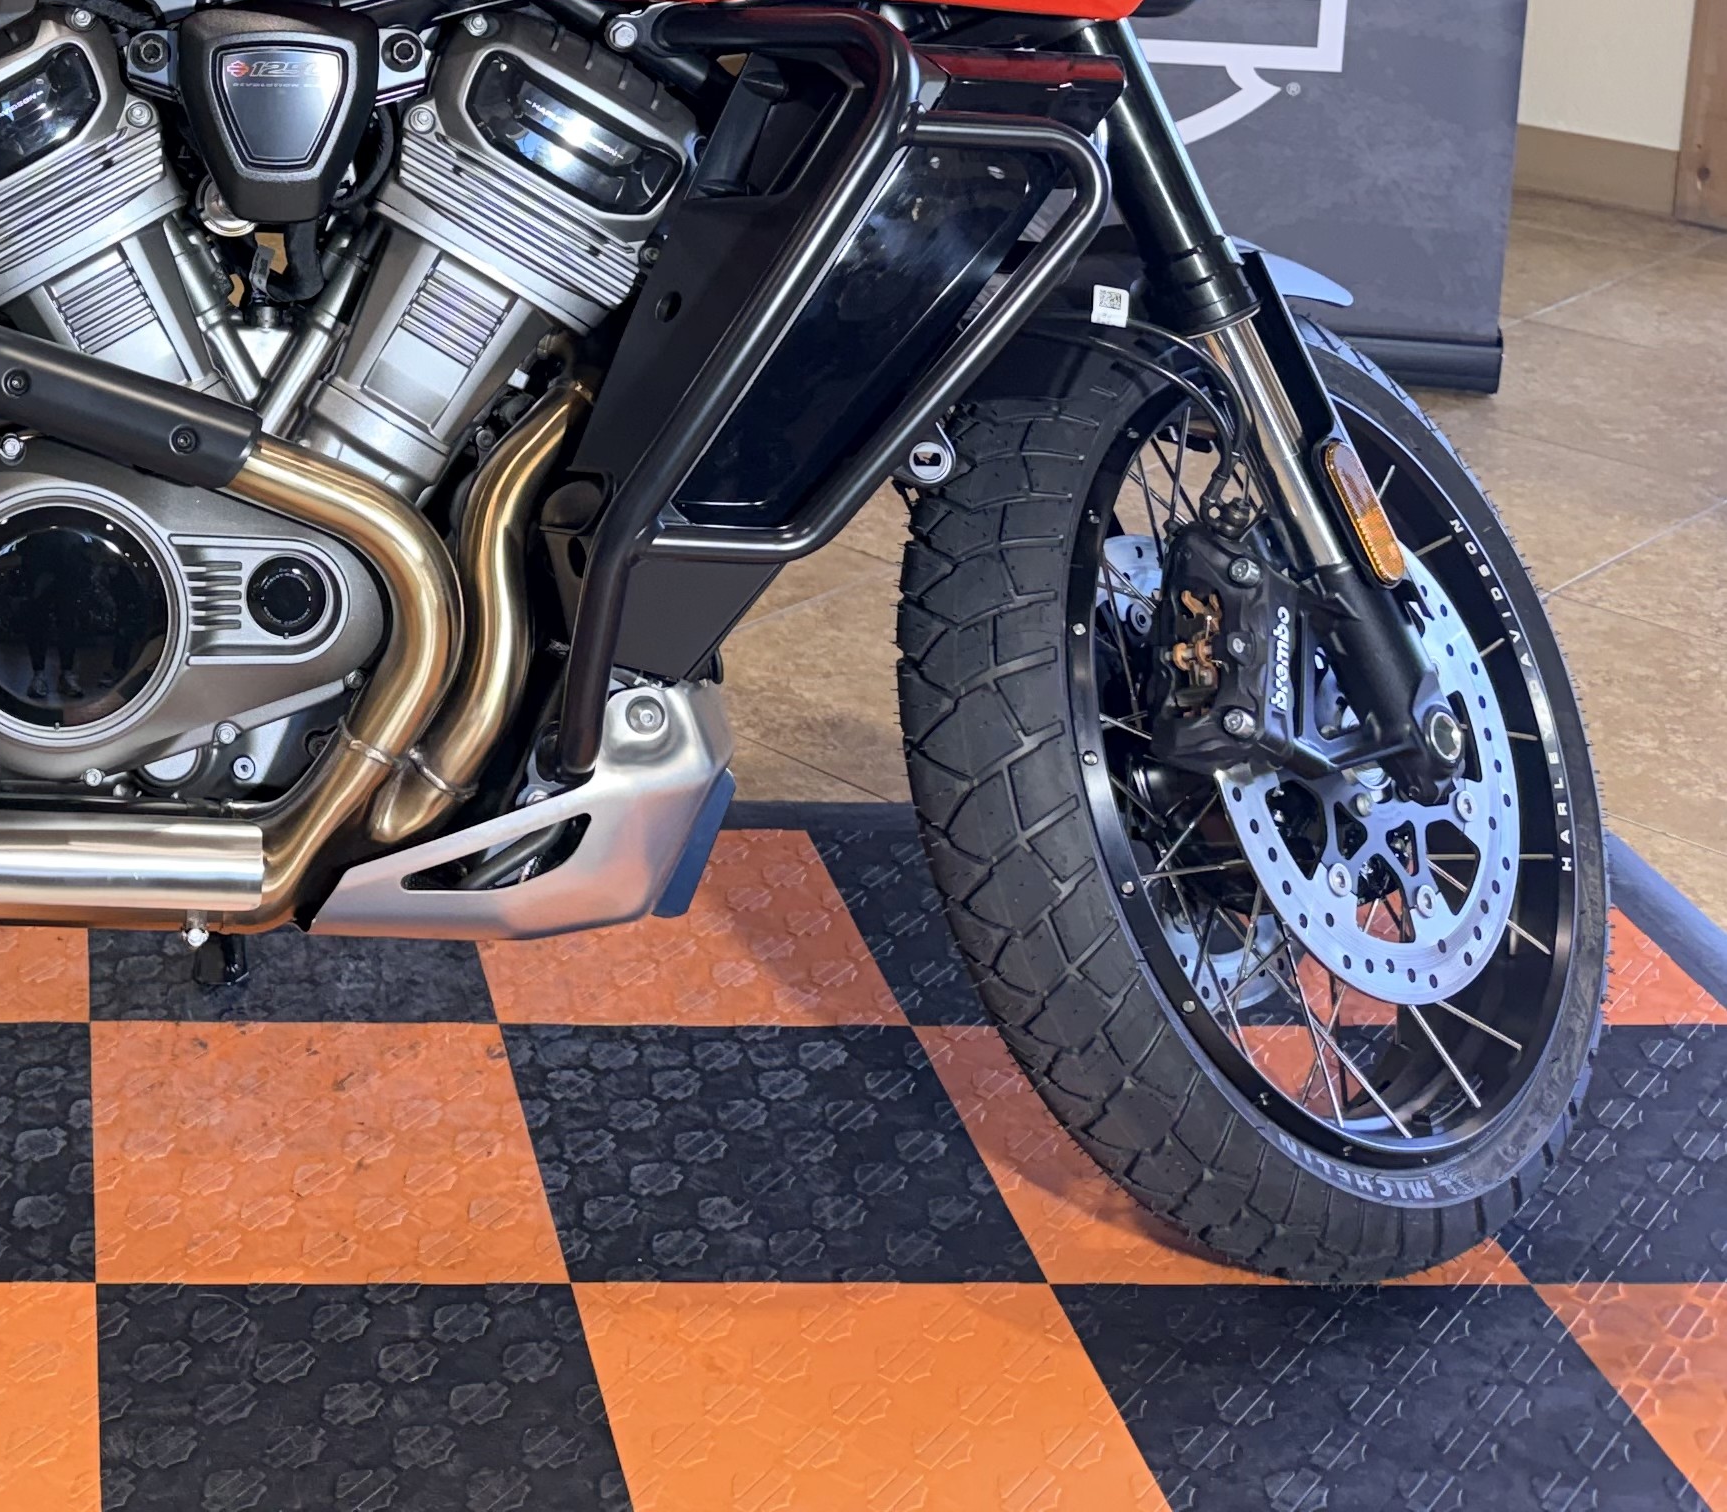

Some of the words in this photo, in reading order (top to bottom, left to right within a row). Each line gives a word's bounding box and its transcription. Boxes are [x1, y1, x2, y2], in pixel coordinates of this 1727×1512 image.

[1270, 606, 1291, 711] brembo
[1449, 518, 1572, 872] HARLEYDAVIDSON
[1278, 1132, 1435, 1199] MICHELIN
